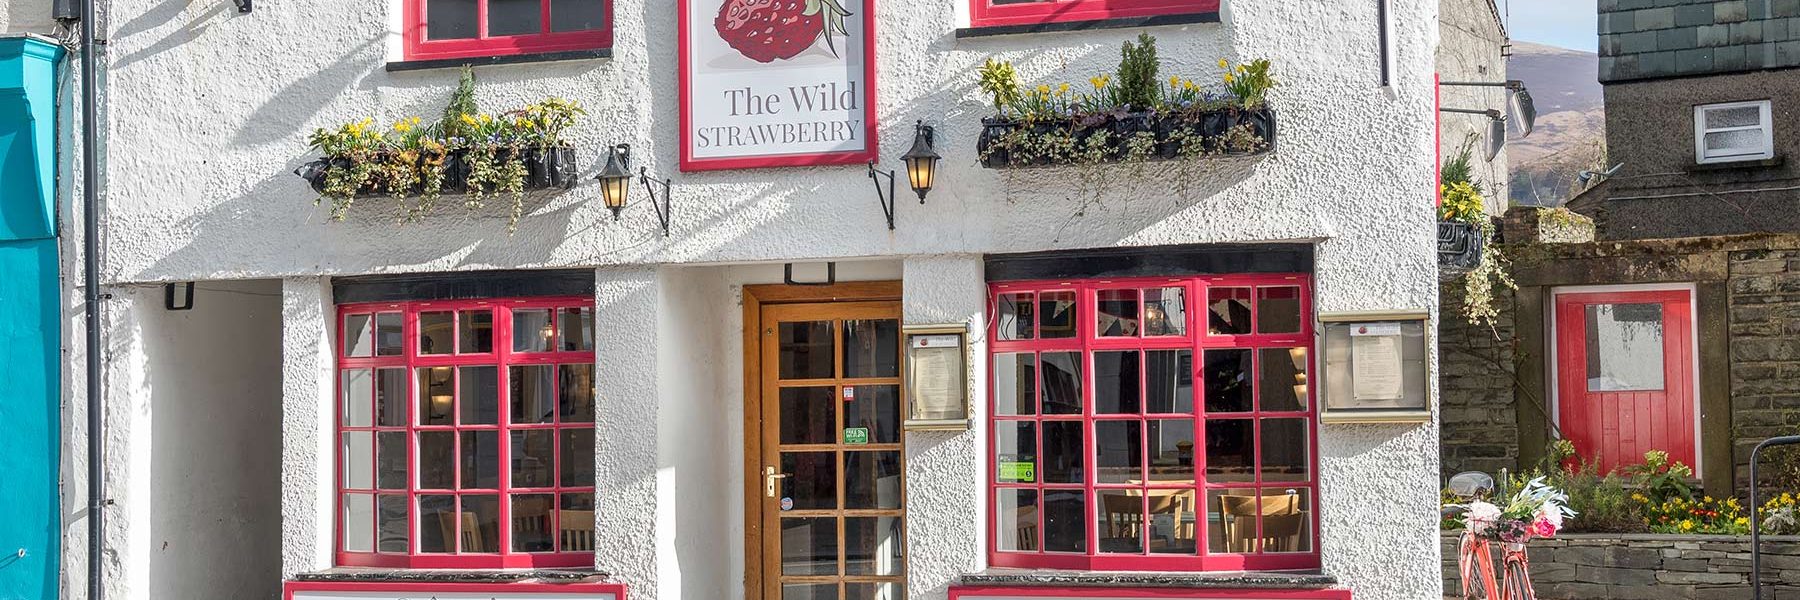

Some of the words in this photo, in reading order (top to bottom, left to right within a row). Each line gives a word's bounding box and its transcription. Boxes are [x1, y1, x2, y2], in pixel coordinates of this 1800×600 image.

[724, 87, 780, 117] The
[789, 81, 858, 113] Wild
[697, 120, 859, 148] STRAWBERRY
